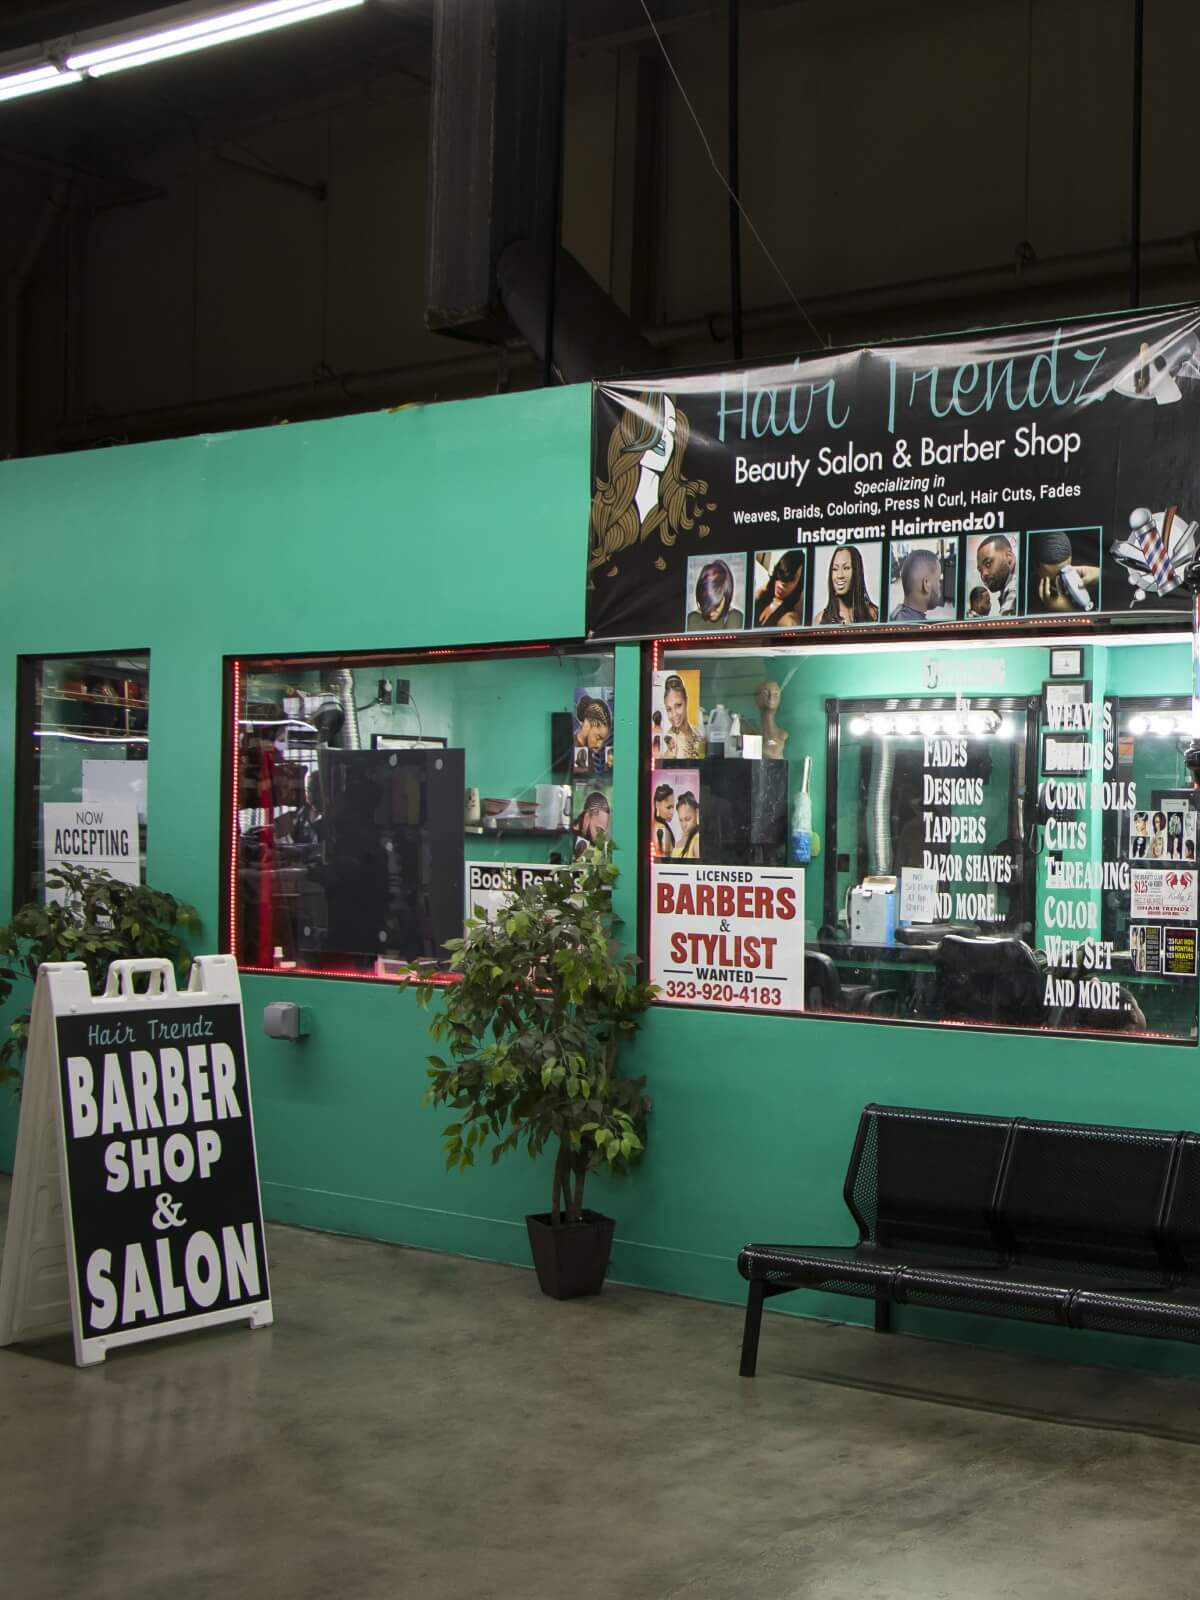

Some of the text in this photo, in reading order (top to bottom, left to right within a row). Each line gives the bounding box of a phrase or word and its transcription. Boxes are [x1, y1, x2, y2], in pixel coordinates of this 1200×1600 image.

[717, 356, 850, 443] Hair
[735, 422, 1081, 487] Beauty Salon & Barber Shop
[854, 474, 945, 497] Specializing in
[733, 483, 1081, 525] Weaves, Braids, Coloring, Press N Curl, Hair Cuts, Fades
[797, 511, 1005, 545] Instagram: Hairtrendz01
[1046, 701, 1112, 730] WEAVS
[923, 736, 968, 768] FADES
[923, 774, 984, 806] DESIGNS
[1045, 778, 1086, 811] CORN
[76, 811, 103, 826] NOW
[923, 811, 986, 844] TAPPERS
[1045, 816, 1087, 850] CUTS
[54, 828, 129, 856] ACCEPTING
[696, 870, 753, 883] LICENSED
[966, 855, 1012, 883] SHAVES
[1045, 856, 1130, 891] THREADING
[656, 882, 796, 920] BARBERS
[928, 892, 953, 921] ND
[1044, 895, 1098, 930] COLOR
[719, 918, 731, 933] &
[670, 931, 778, 970] STYLIST
[1044, 934, 1080, 969] WET
[1083, 937, 1114, 970] SET
[696, 967, 753, 983] WANTED
[1043, 974, 1075, 1008] AND
[666, 980, 782, 1006] 323-920-4183
[88, 1014, 215, 1046] Hair Trendz
[67, 1042, 242, 1139] BARBER
[104, 1129, 222, 1193] SHOP
[151, 1192, 188, 1230] &
[86, 1222, 261, 1330] SALON
